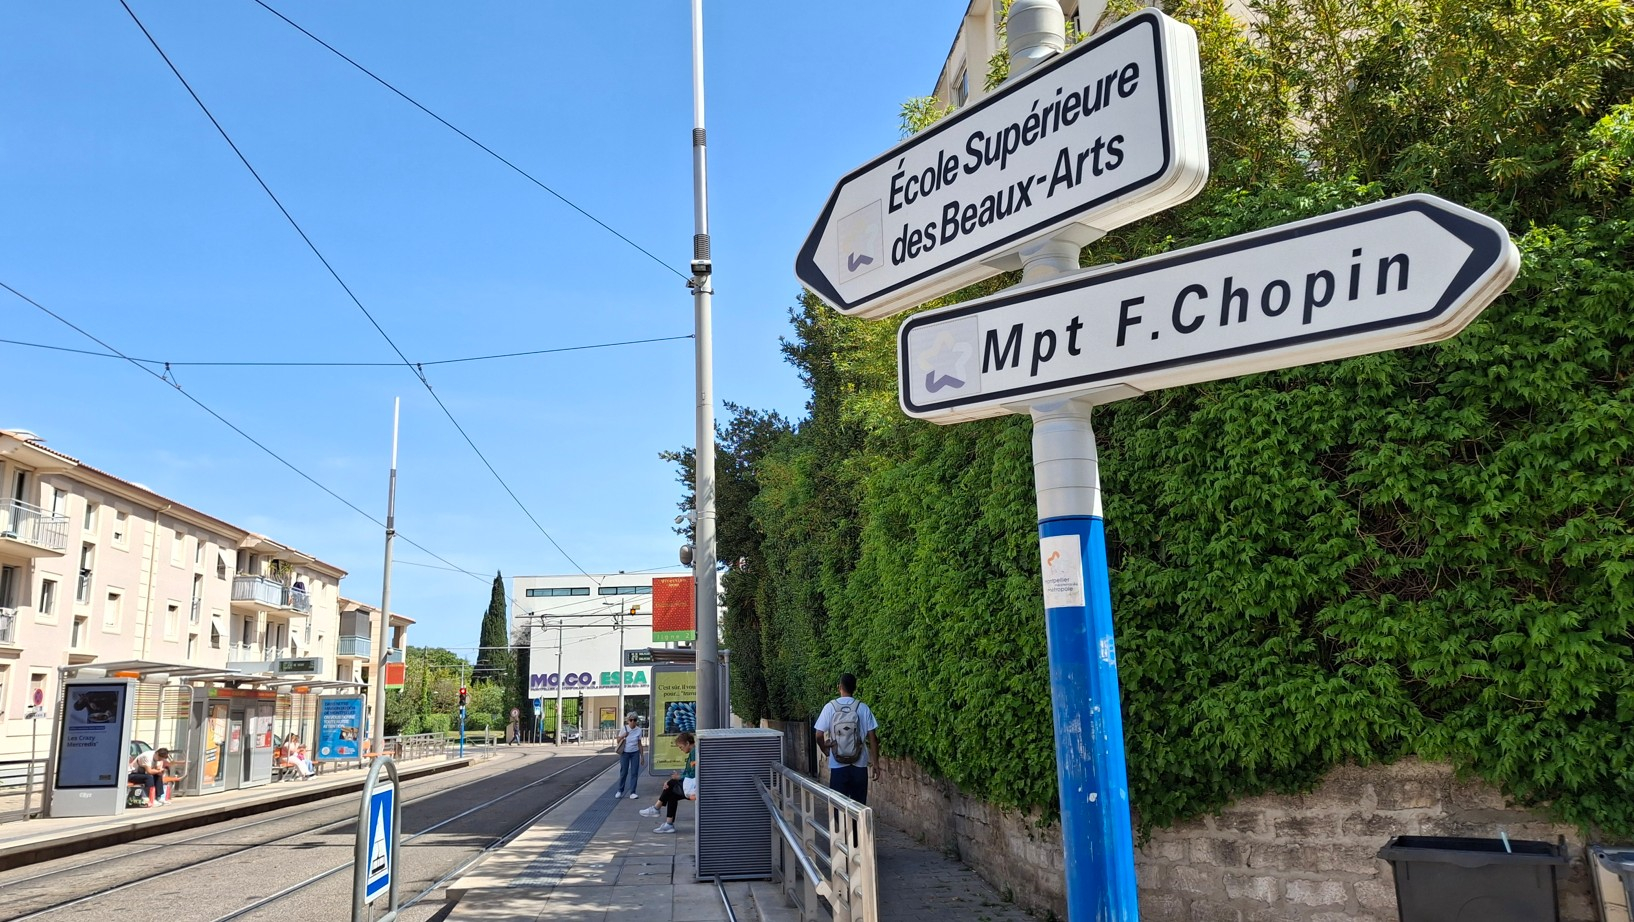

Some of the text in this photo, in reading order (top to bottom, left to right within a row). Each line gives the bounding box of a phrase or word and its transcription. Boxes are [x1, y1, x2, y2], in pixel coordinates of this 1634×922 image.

[888, 61, 1140, 214] École Supérieure
[891, 134, 1125, 266] des Beaux-Arts
[981, 314, 1084, 377] Mpt
[600, 671, 647, 685] ESBA
